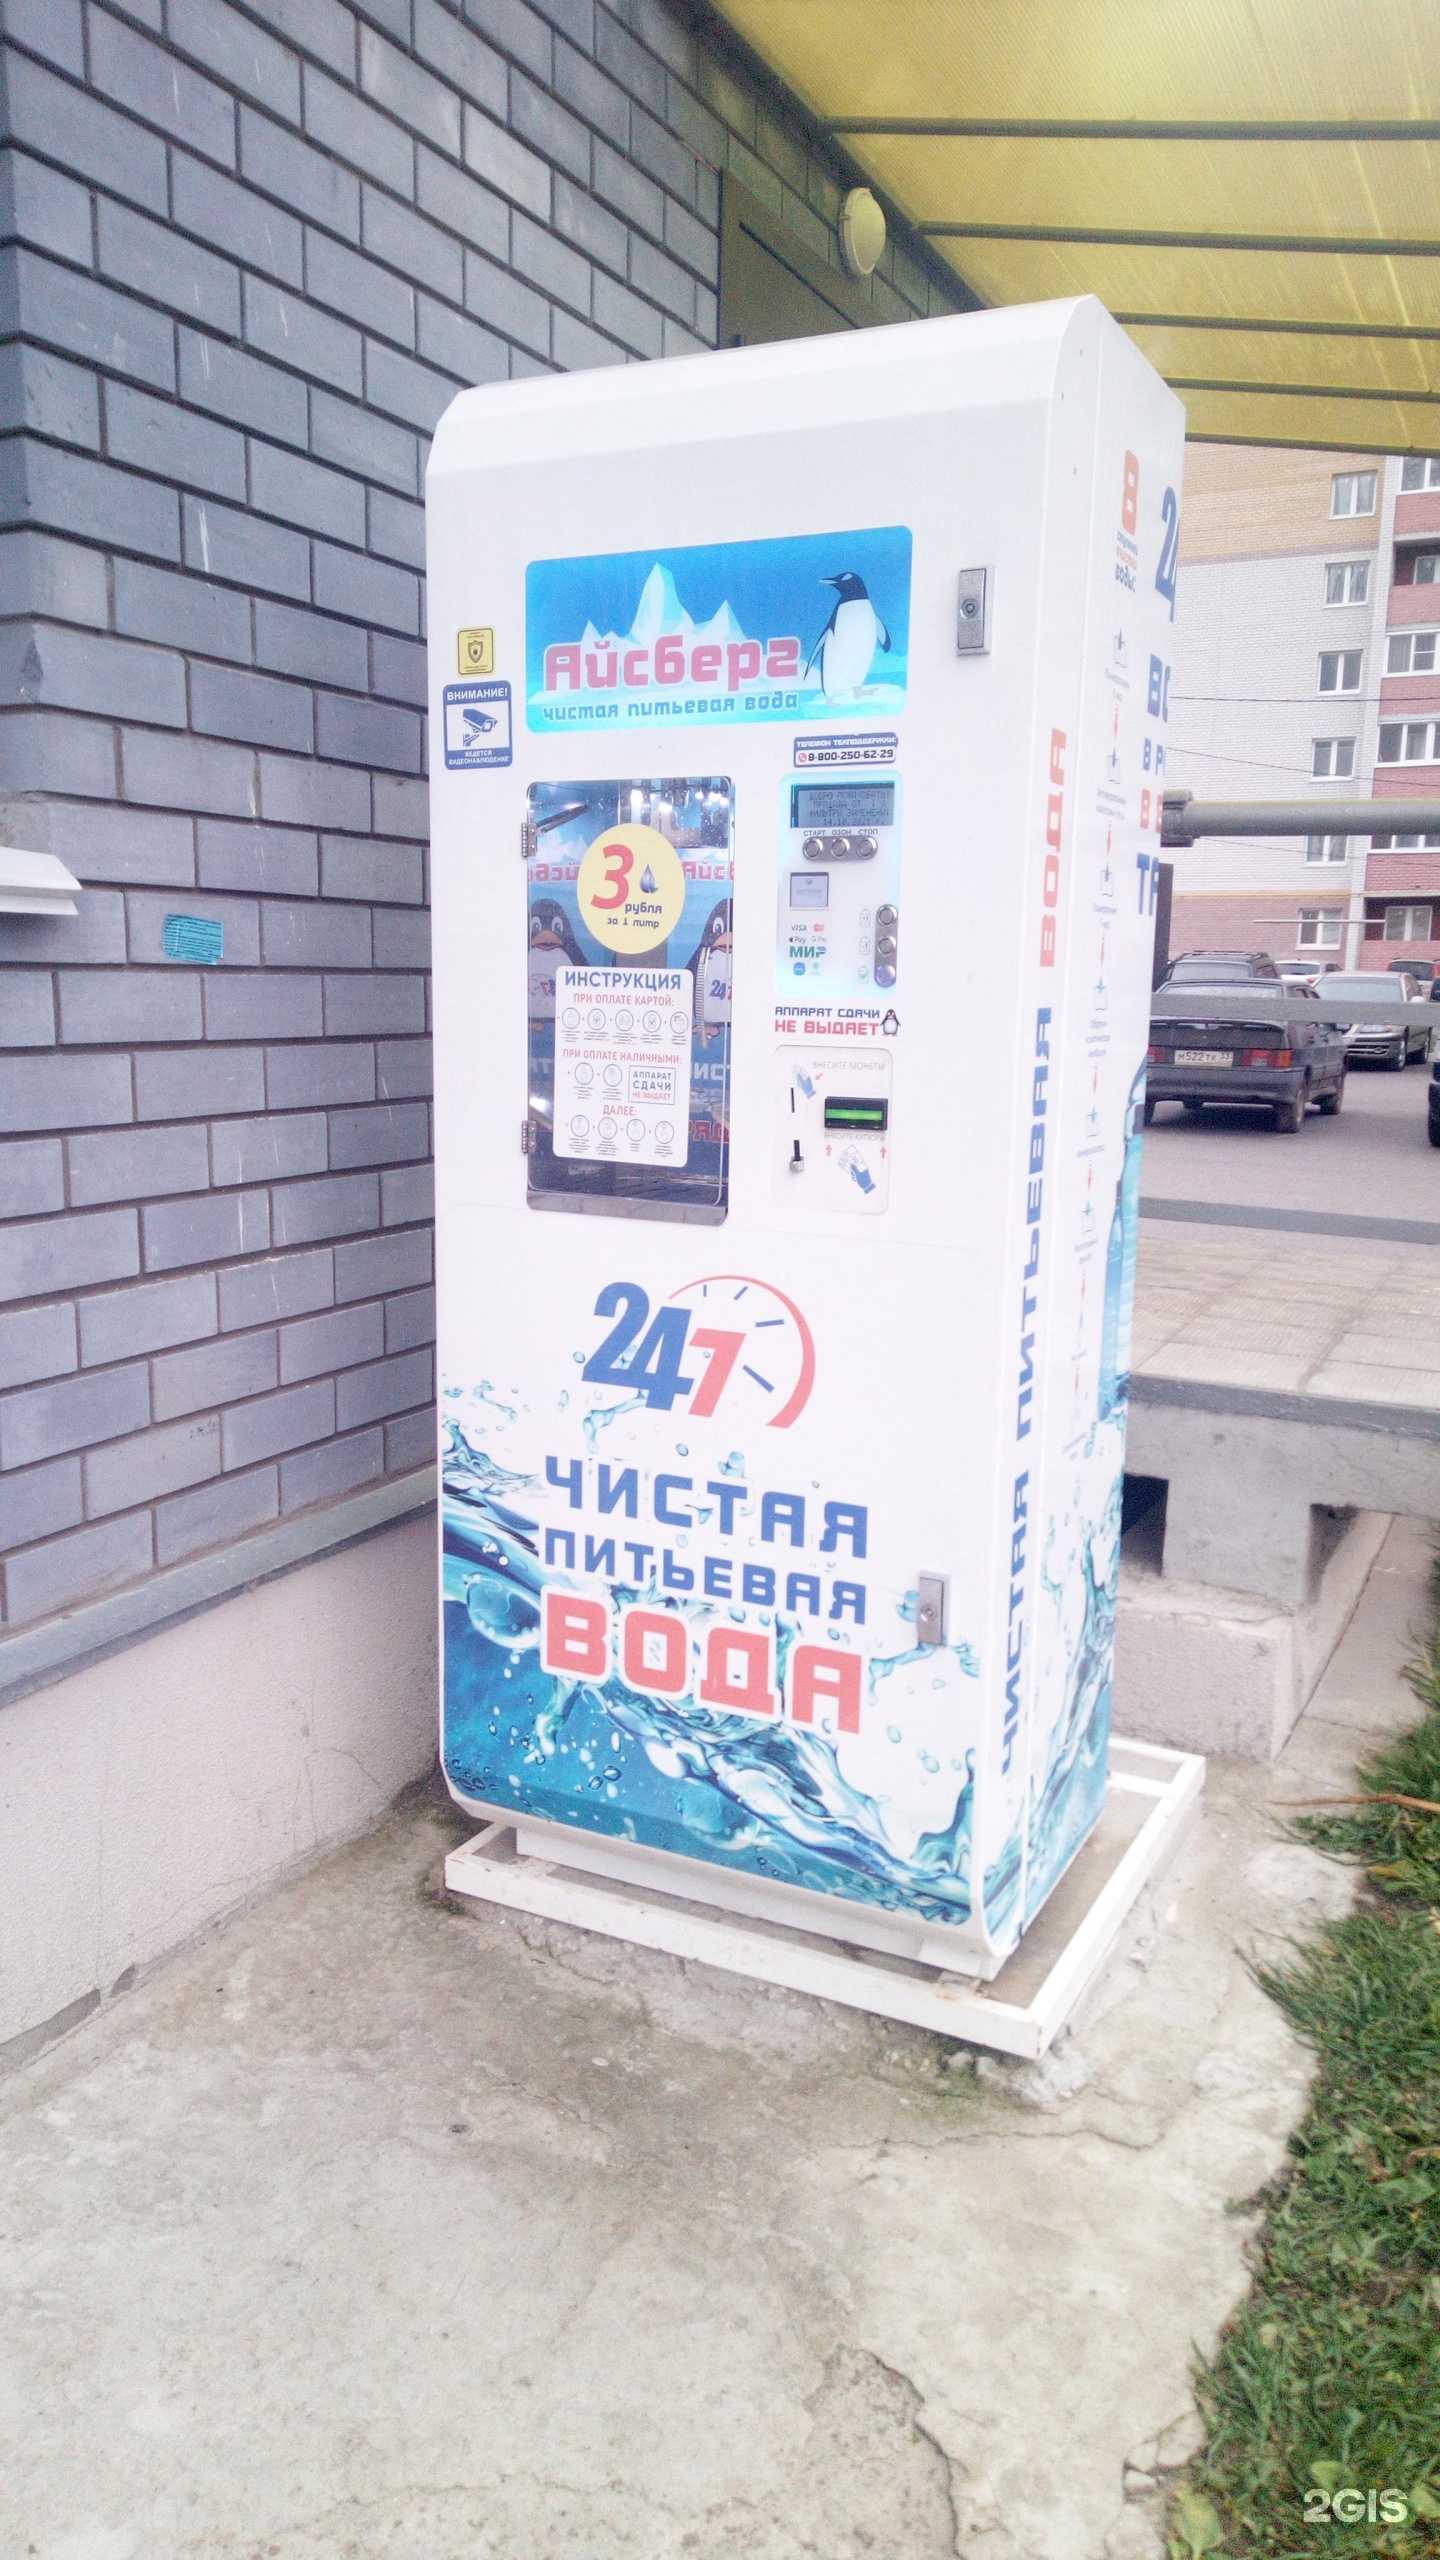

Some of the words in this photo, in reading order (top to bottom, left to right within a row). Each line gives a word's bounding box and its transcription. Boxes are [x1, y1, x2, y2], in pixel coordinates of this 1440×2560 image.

[543, 636, 800, 692] Айсберг
[447, 687, 508, 701] ВНИМАНИЕ!
[543, 701, 619, 722] чистая
[627, 695, 736, 718] питьевая
[744, 691, 799, 712] вода
[807, 749, 894, 761] 8-800-250-62-29
[591, 844, 634, 910] 3
[624, 901, 662, 916] рубля
[607, 918, 618, 926] за
[623, 918, 629, 926] 1
[633, 918, 659, 930] литр
[789, 946, 826, 958] МИР
[565, 971, 681, 992] ИНСТРУКЦИЯ
[574, 993, 592, 1004] ПРИ
[595, 994, 631, 1005] ОПЛАТЕ
[634, 994, 674, 1006] КАРТОЙ:
[775, 1006, 832, 1017] АППАРАТ
[838, 1008, 880, 1018] СДАЧИ
[775, 1020, 796, 1033] НЕ
[804, 1021, 879, 1035] ВЫДАЕТ
[563, 1048, 580, 1058] ПРИ
[583, 1049, 617, 1060] ОПЛАТЕ
[620, 1052, 682, 1064] НАЛИЧНЫМИ:
[633, 1071, 671, 1080] АППАРАТ
[633, 1081, 671, 1091] СДАЧИ
[602, 1104, 638, 1116] ДАЛЕЕ:
[1001, 1469, 1030, 1776] ЧИСТАЯ
[1016, 1007, 1052, 1442] ПИТЬЕВАЯ
[1040, 727, 1067, 968] ВОДА
[545, 1455, 868, 1560] ЧИСТАЯ
[545, 1527, 867, 1625] ПИТЬЕВАЯ
[546, 1592, 862, 1735] ВОДА
